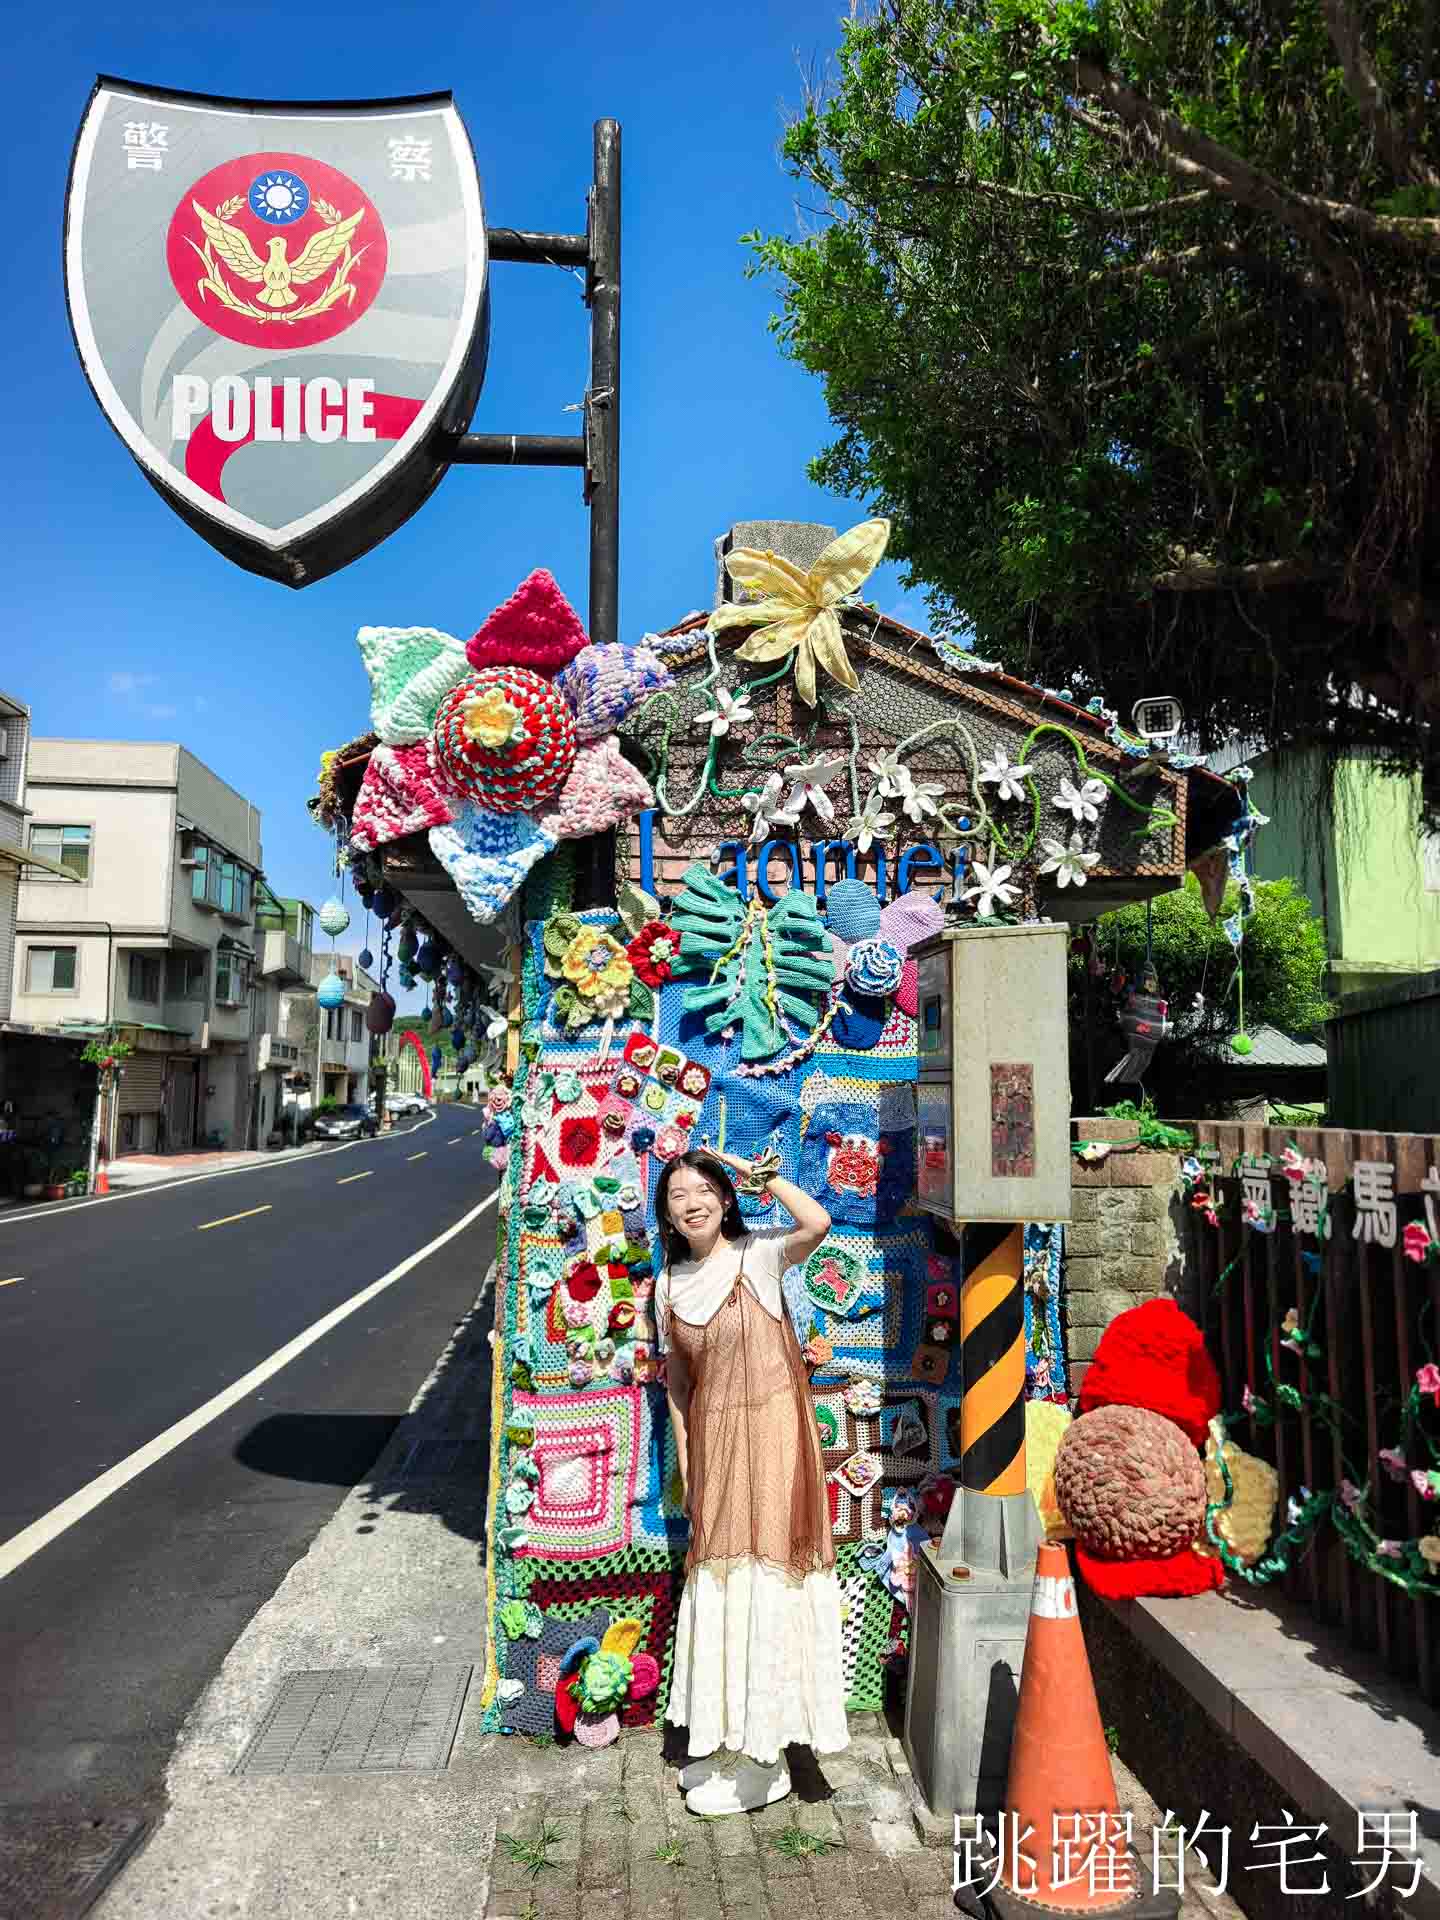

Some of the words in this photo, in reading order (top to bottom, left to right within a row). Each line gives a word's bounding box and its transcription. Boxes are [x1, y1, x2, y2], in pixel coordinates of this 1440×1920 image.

[121, 120, 169, 171] 警
[385, 135, 433, 180] 察
[171, 374, 376, 443] POLICE
